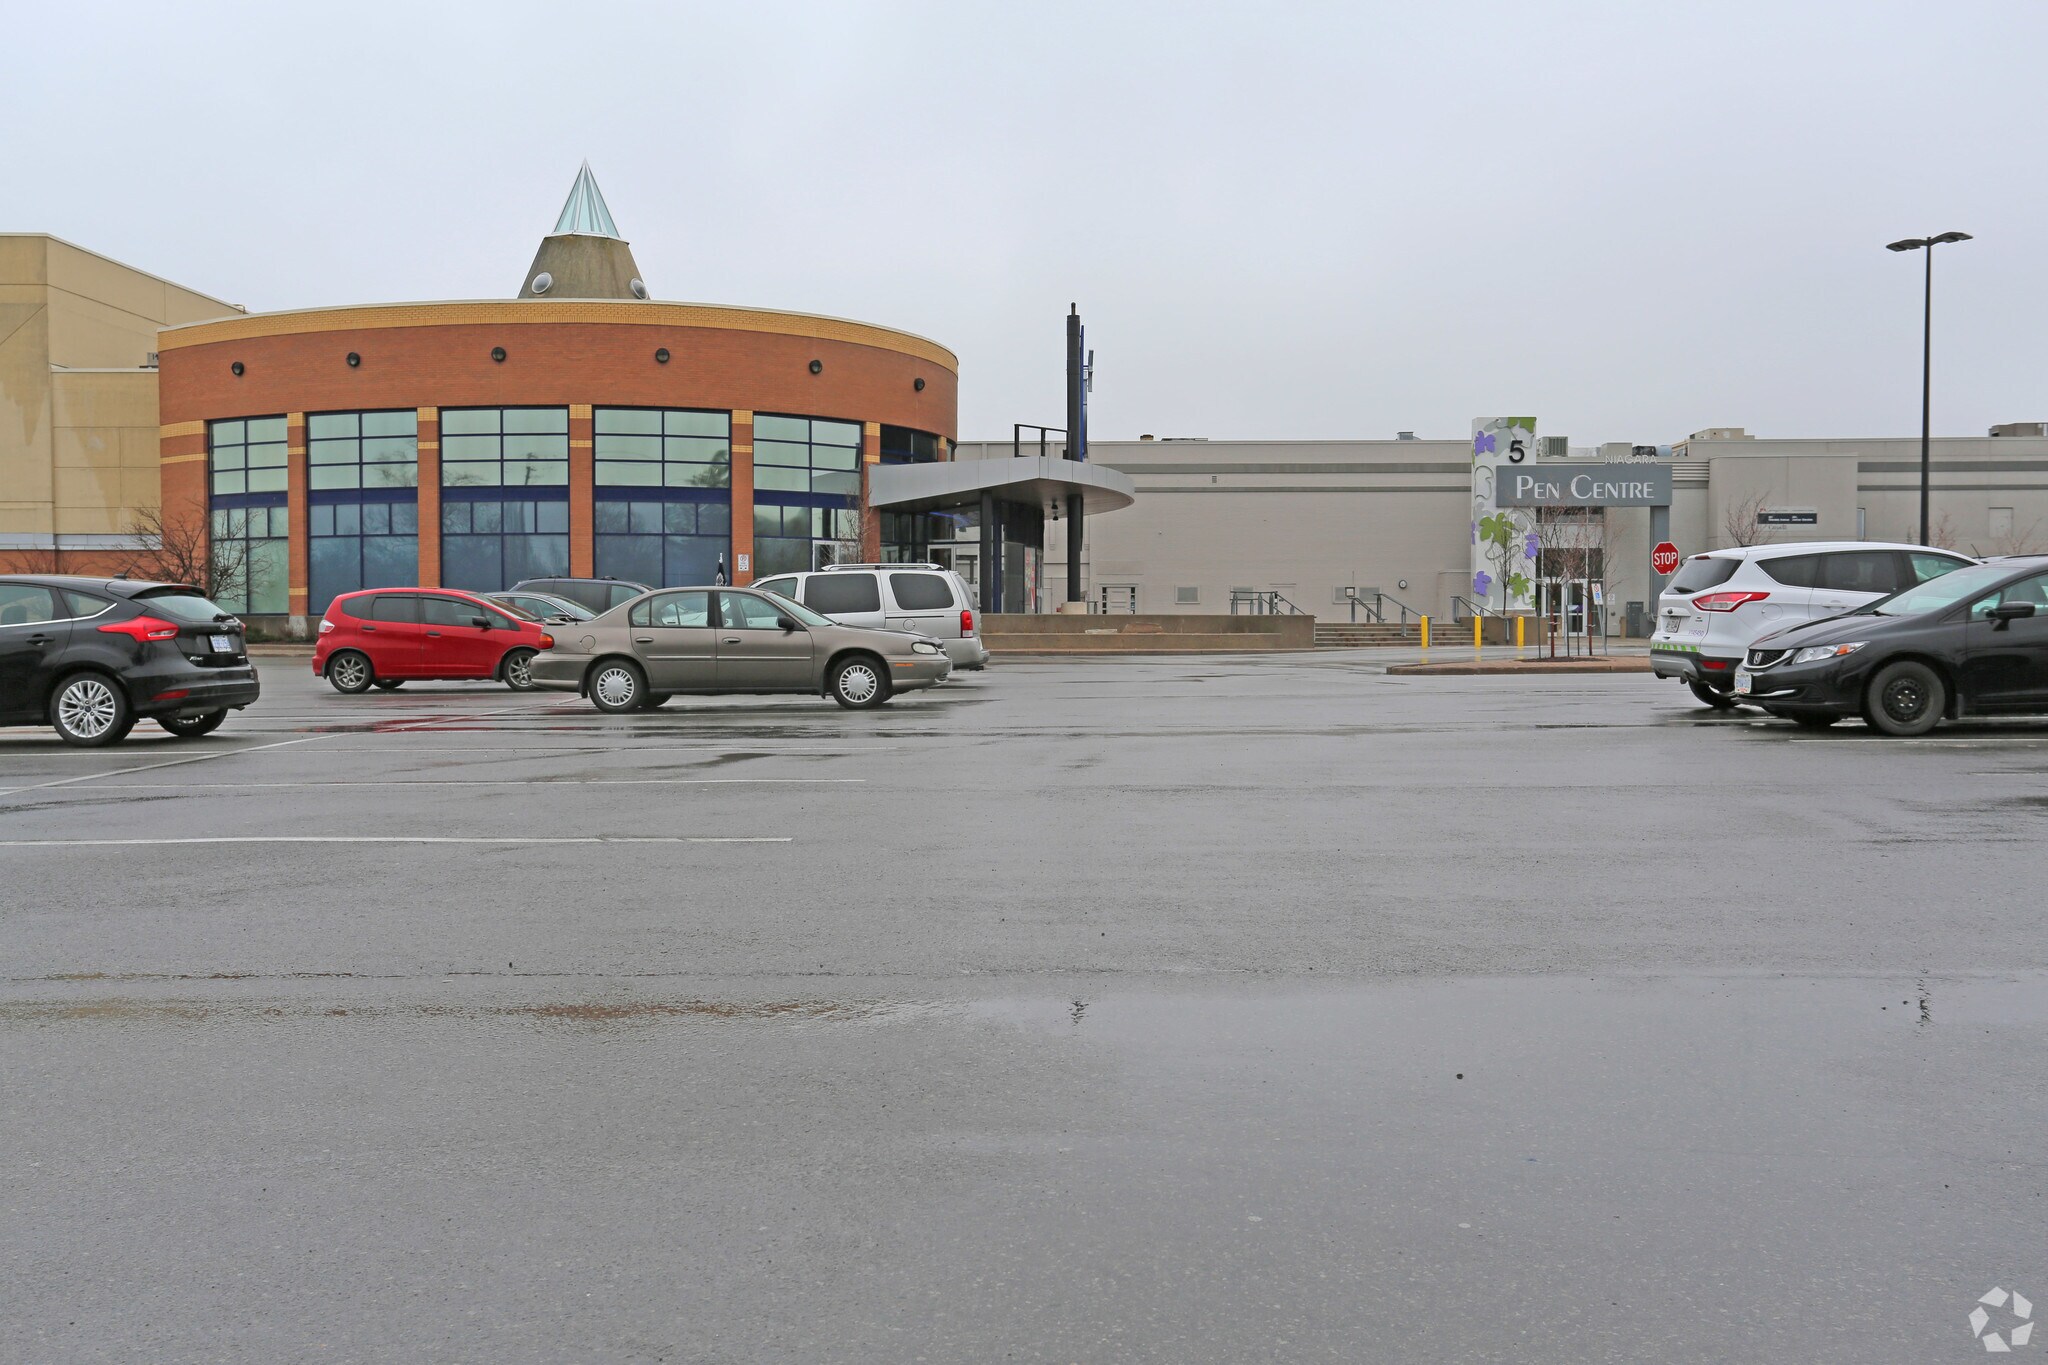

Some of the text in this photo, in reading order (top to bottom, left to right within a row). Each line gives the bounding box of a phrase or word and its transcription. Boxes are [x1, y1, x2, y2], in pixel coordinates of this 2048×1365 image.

[1508, 439, 1525, 464] 5
[1605, 454, 1657, 465] NIAGARA
[1516, 474, 1655, 499] PEN CENTRE
[1653, 551, 1678, 566] STOP
